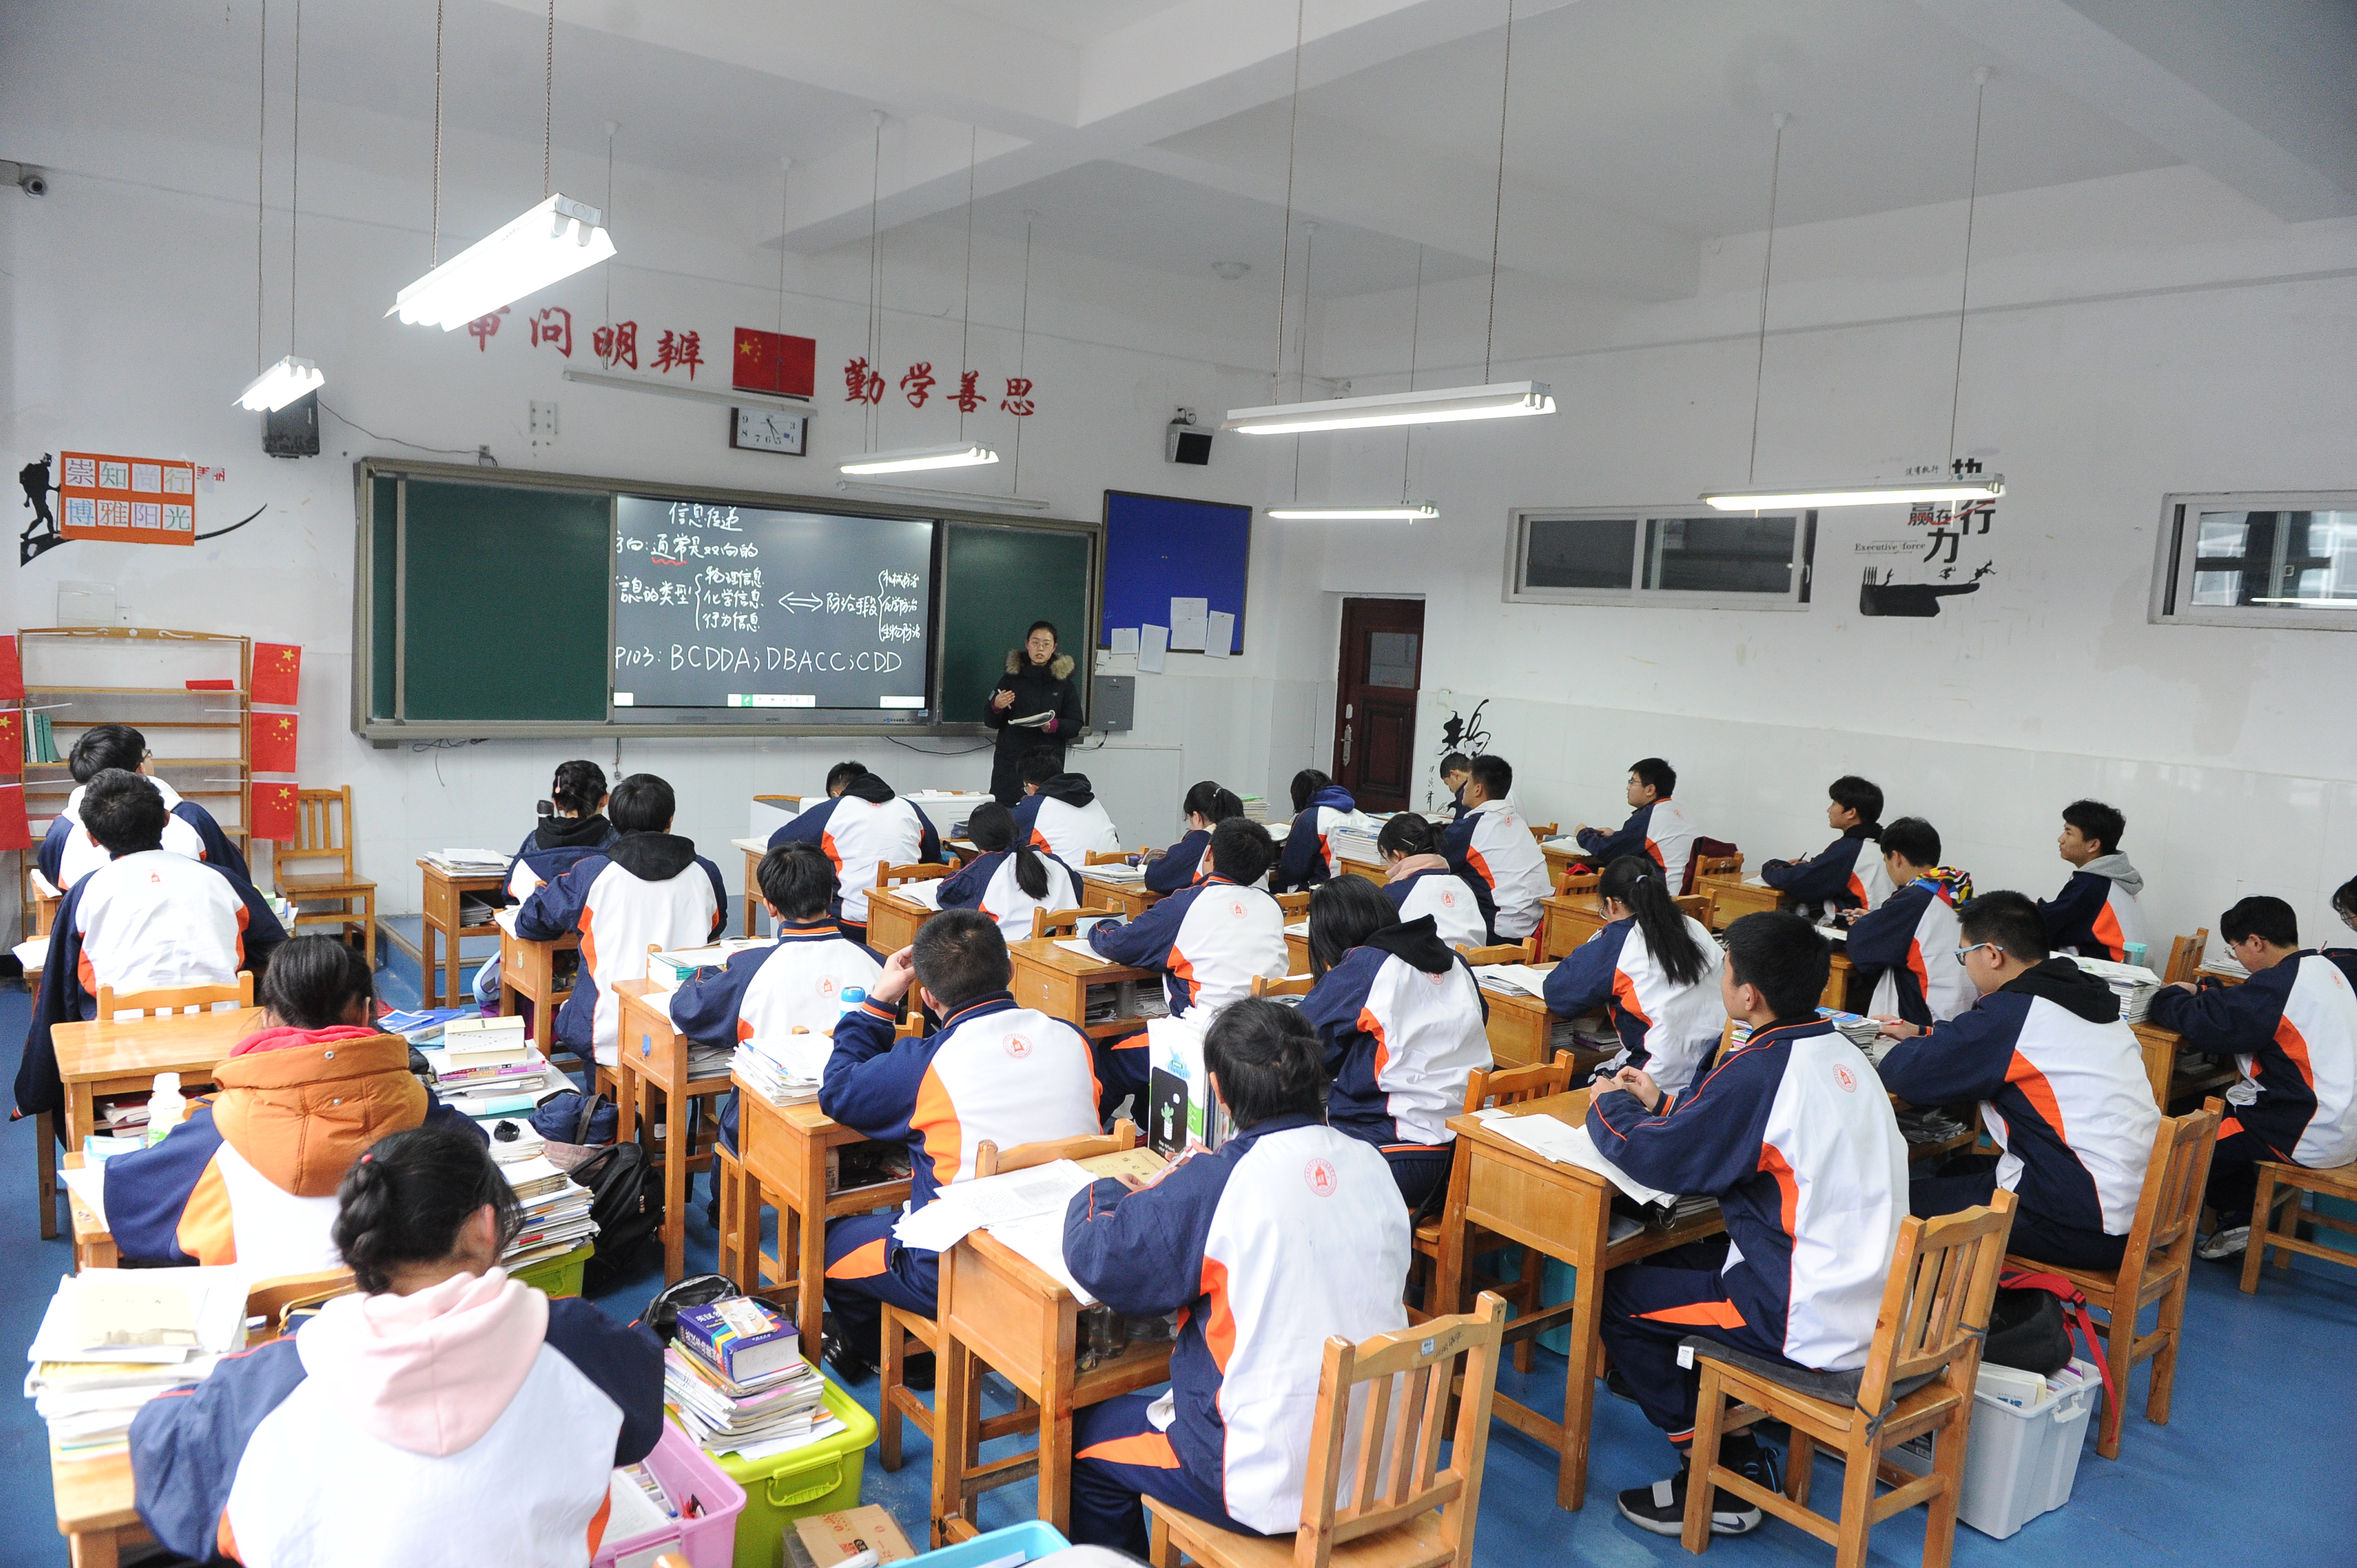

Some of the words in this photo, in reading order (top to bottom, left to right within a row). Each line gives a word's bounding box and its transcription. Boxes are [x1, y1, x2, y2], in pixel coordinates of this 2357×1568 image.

[845, 357, 1035, 416] 勤学善思
[67, 459, 191, 492] 崇知尚行
[66, 500, 191, 530] 博雅阳光
[1855, 543, 1898, 551] Executive
[1902, 542, 1926, 550] force
